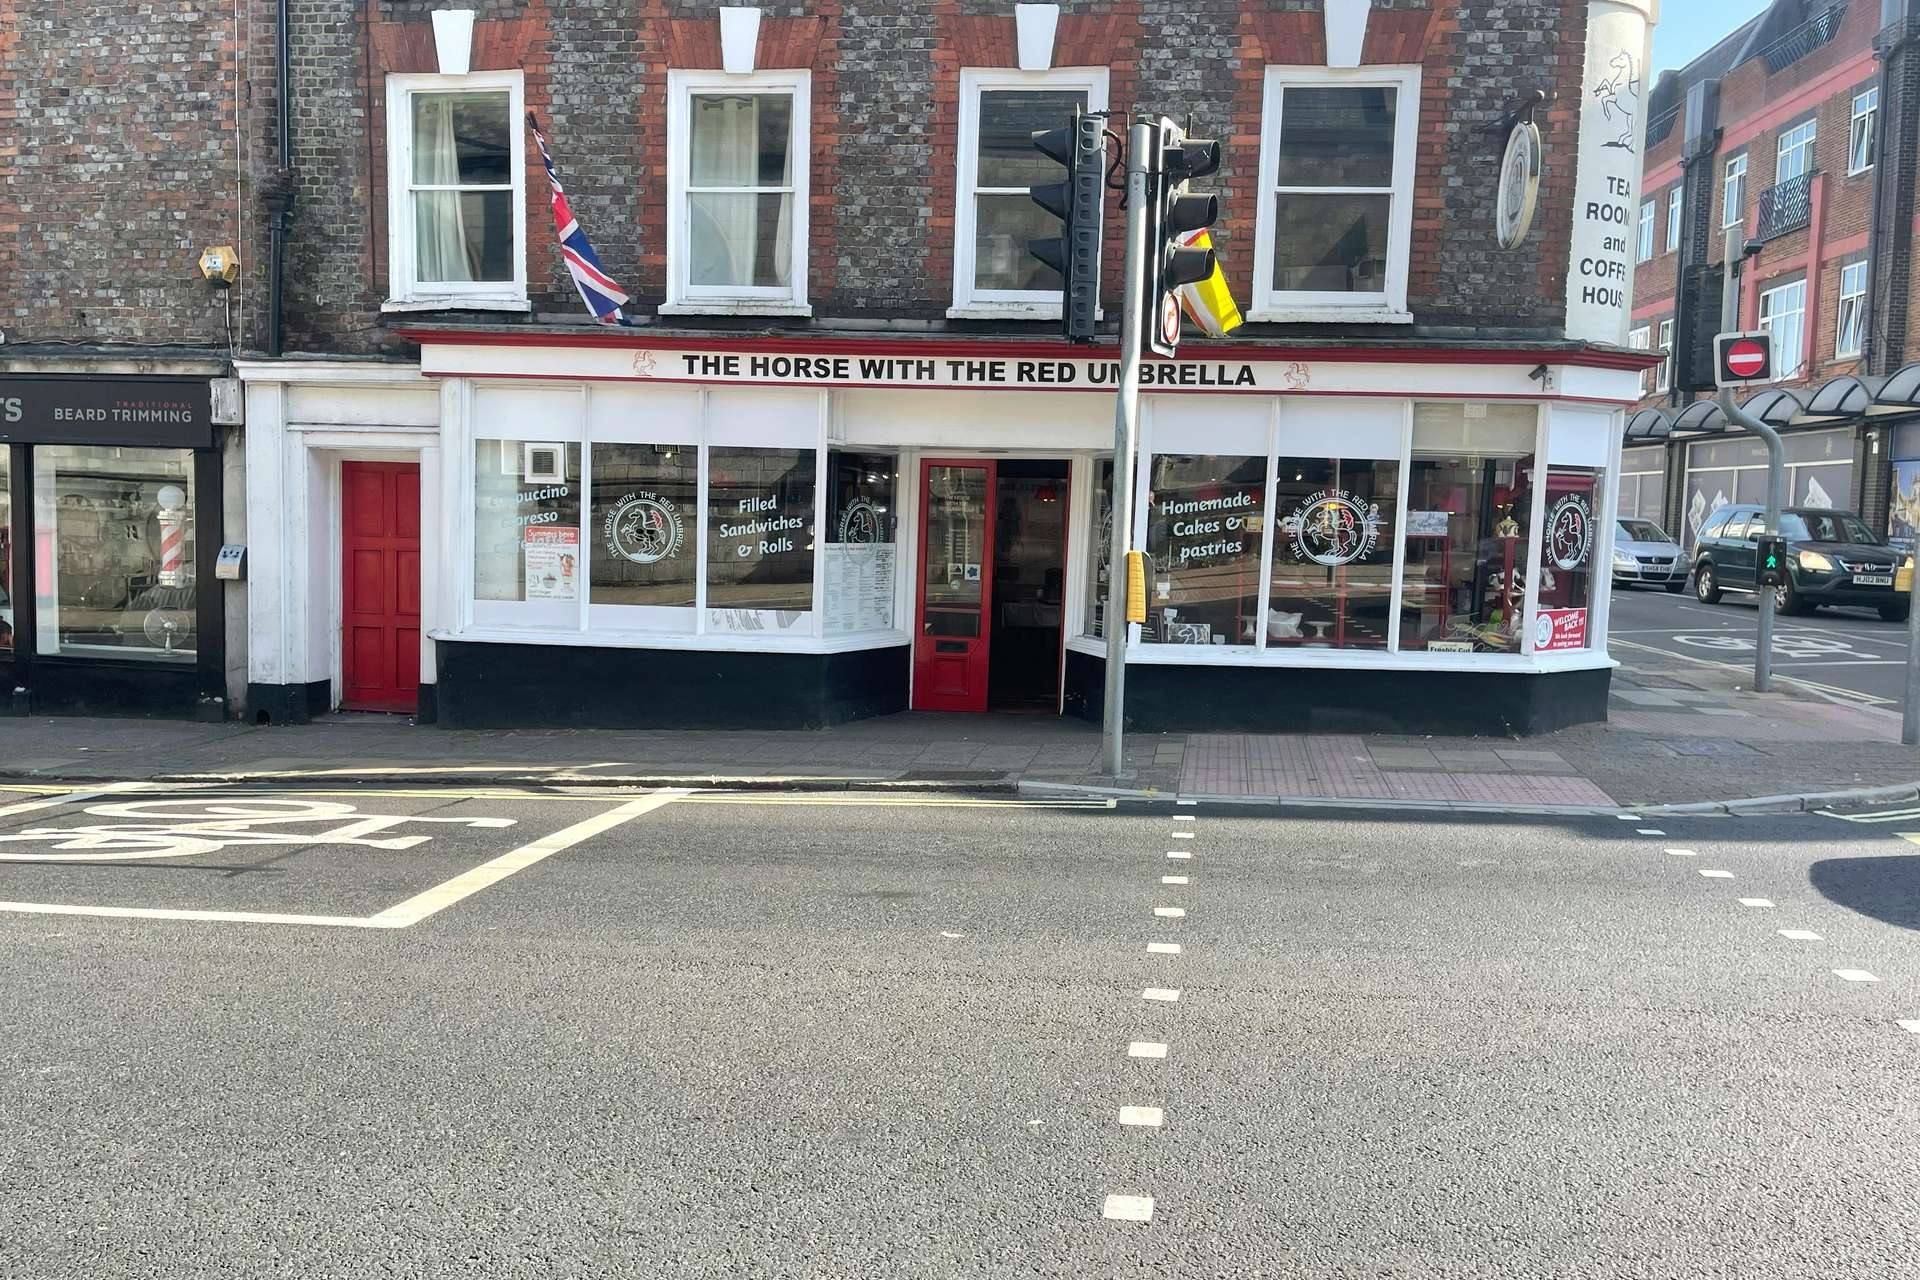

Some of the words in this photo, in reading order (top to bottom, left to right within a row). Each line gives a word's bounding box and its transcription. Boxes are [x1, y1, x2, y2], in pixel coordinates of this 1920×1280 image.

[1606, 175, 1630, 199] TEA
[1603, 236, 1626, 253] and
[682, 354, 740, 376] THE
[750, 356, 849, 379] HORSE
[859, 359, 935, 381] WITH
[946, 360, 1006, 382] THE
[1017, 361, 1076, 383] RED
[0, 397, 23, 422] S
[116, 401, 193, 409] TRADITIONAL
[54, 408, 107, 421] BEARD
[112, 409, 193, 423] TRIMMING
[615, 492, 636, 508] WITH
[640, 491, 657, 500] THE
[659, 496, 675, 512] RED
[738, 495, 777, 514] Filled
[1161, 491, 1251, 516] Homemade
[1570, 493, 1581, 503] THE
[603, 508, 617, 538] HORSE
[719, 515, 803, 538] Sandwiches
[1172, 515, 1220, 537] Cakes
[1225, 516, 1243, 530] &
[1289, 541, 1304, 560] THE
[1302, 490, 1326, 506] WITH
[1331, 488, 1350, 499] THE
[1351, 495, 1369, 511] RED
[668, 513, 684, 558] UMBRELLA
[606, 541, 619, 559] THE
[737, 544, 753, 557] &
[758, 538, 793, 555] Rolls
[1179, 540, 1243, 563] pastries
[1553, 611, 1579, 627] WELCOME
[1564, 620, 1578, 631] BACK
